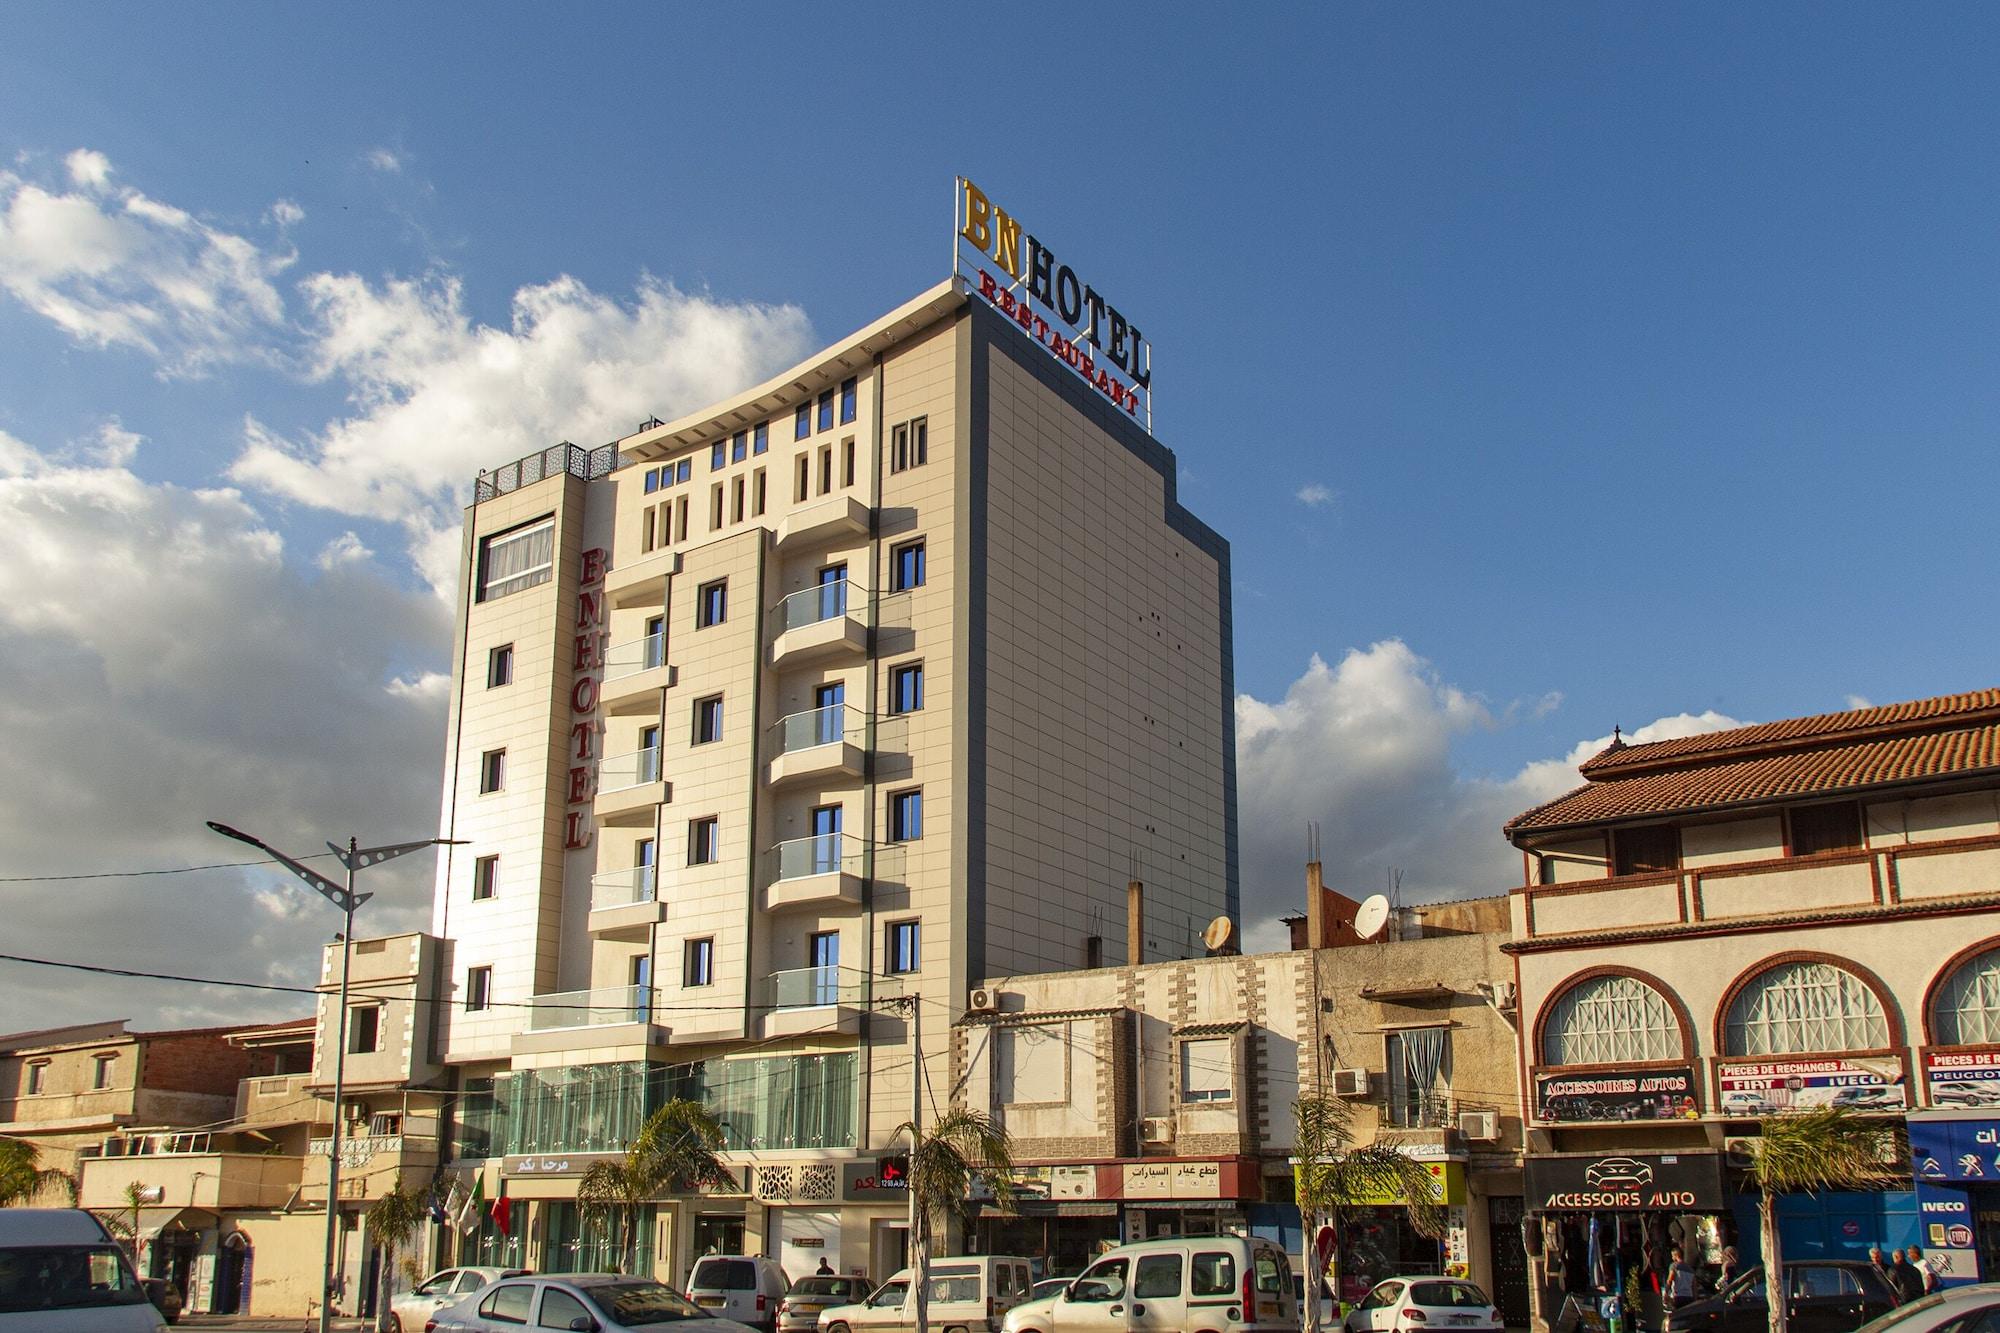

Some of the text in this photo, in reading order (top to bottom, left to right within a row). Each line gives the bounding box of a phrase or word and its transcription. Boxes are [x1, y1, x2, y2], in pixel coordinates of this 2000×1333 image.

[962, 178, 1151, 390] BN HOTEL
[977, 268, 1139, 416] RESTAURANT
[1935, 1055, 1973, 1066] PIECES
[1975, 1055, 1992, 1065] DE
[1725, 1065, 1759, 1076] PIECES
[1761, 1064, 1775, 1074] DE
[1776, 1062, 1838, 1074] RECHANGES
[1545, 1077, 1687, 1096] ACCESSOIRES AUTOS
[1734, 1079, 1774, 1090] FIAT
[1829, 1075, 1882, 1086] IVECO
[541, 1158, 569, 1172] مرحبا
[1132, 1164, 1218, 1179] قطع غيار السيارات
[1546, 1192, 1695, 1207] ACCESSOIRS AUTO
[1922, 1201, 1965, 1212] IVECO
[1952, 1231, 1968, 1243] FIAT
